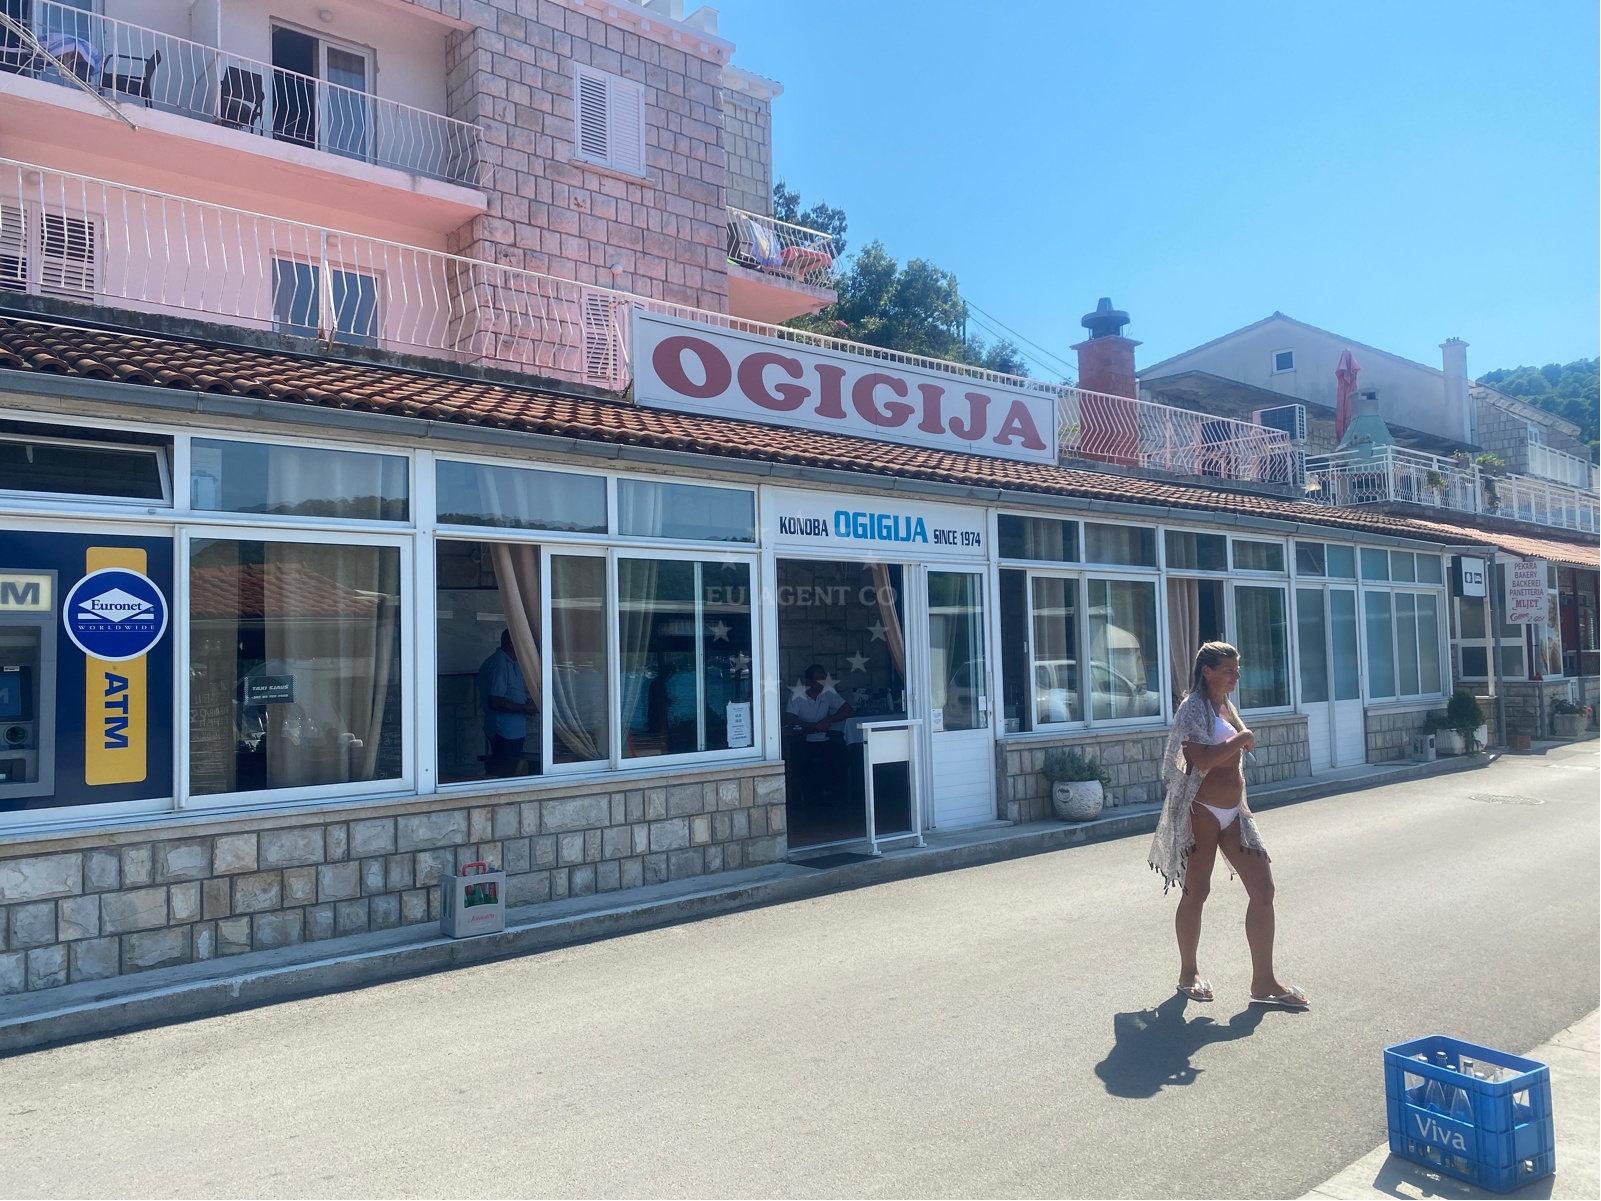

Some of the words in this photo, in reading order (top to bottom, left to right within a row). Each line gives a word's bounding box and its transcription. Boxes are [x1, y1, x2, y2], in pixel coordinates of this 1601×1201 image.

[652, 336, 1047, 450] OGIGIJA
[779, 516, 829, 537] KONOBA
[834, 510, 929, 544] OGIGIJA
[933, 528, 957, 546] SINCE
[960, 531, 981, 547] 1974
[1514, 562, 1537, 570] PEKARA
[1514, 571, 1537, 579] BAKERY
[1509, 588, 1544, 597] PANETTERIA
[91, 599, 142, 611] Euronet
[1515, 599, 1540, 610] MLJET
[104, 672, 129, 749] ATM
[1415, 1113, 1467, 1151] Viva
